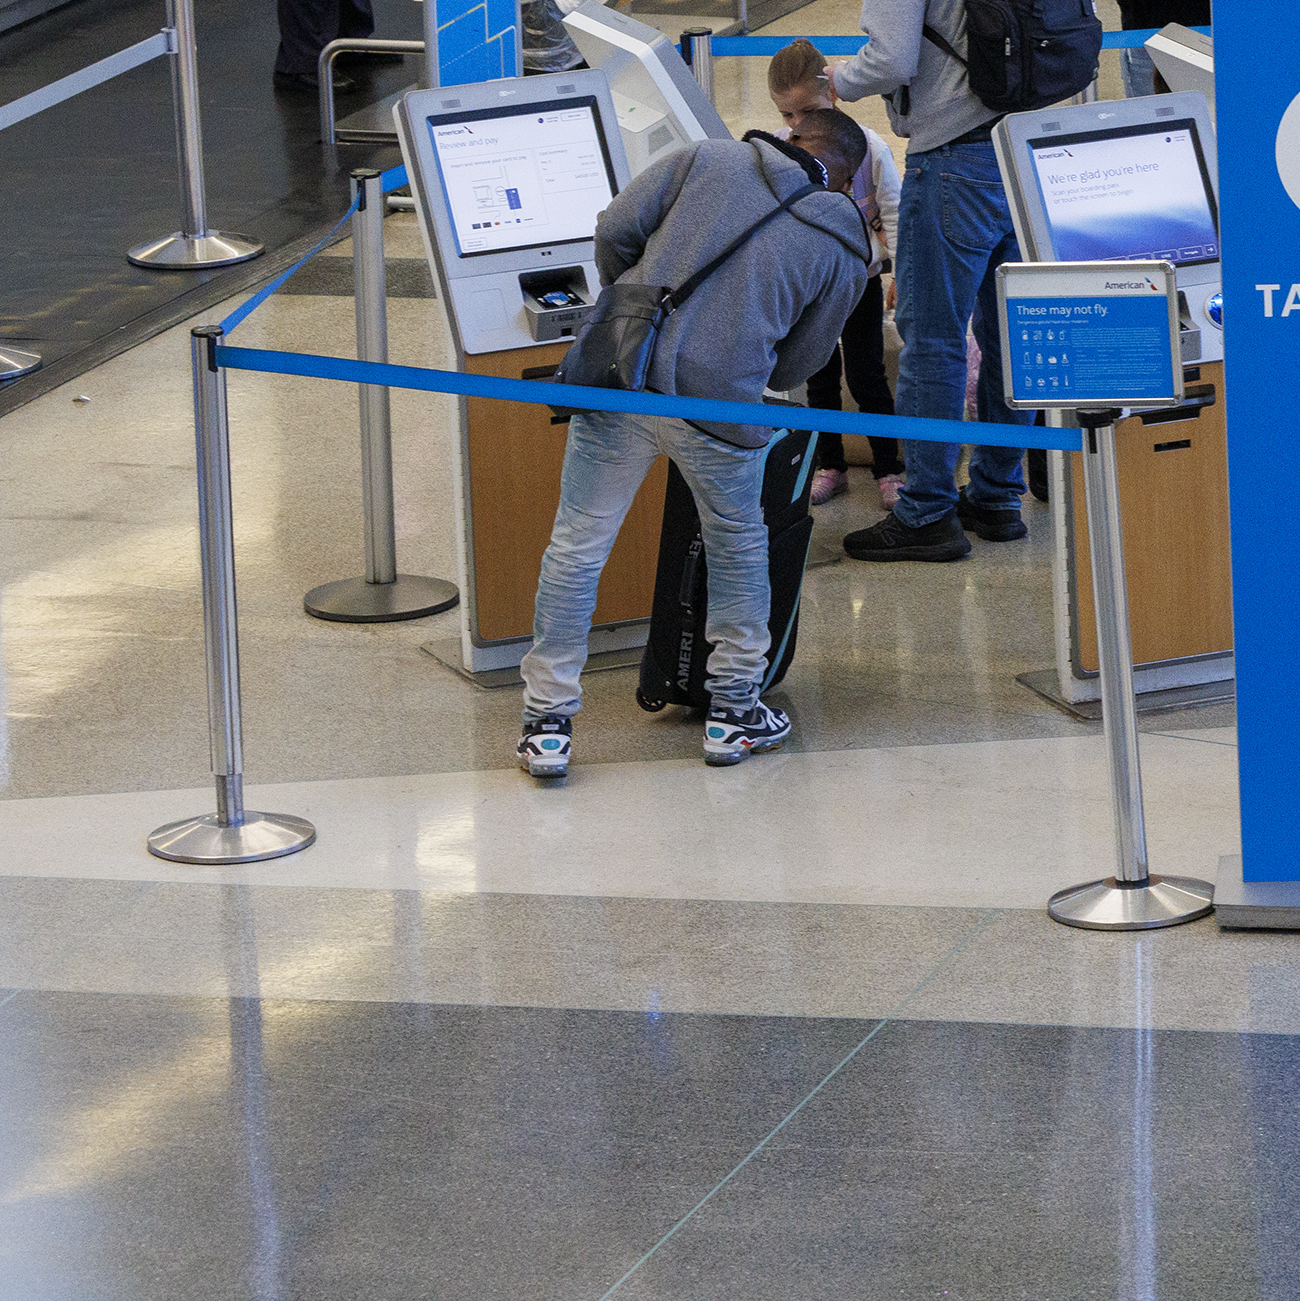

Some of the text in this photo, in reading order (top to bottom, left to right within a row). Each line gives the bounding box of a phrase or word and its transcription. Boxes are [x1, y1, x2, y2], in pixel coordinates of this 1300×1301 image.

[437, 128, 465, 137] American
[440, 136, 499, 151] Review and pay
[1037, 151, 1065, 160] American
[1047, 161, 1160, 185] We're glad you're here
[1104, 281, 1145, 290] American
[1016, 305, 1047, 315] These
[1049, 307, 1071, 317] may
[1074, 305, 1092, 315] not
